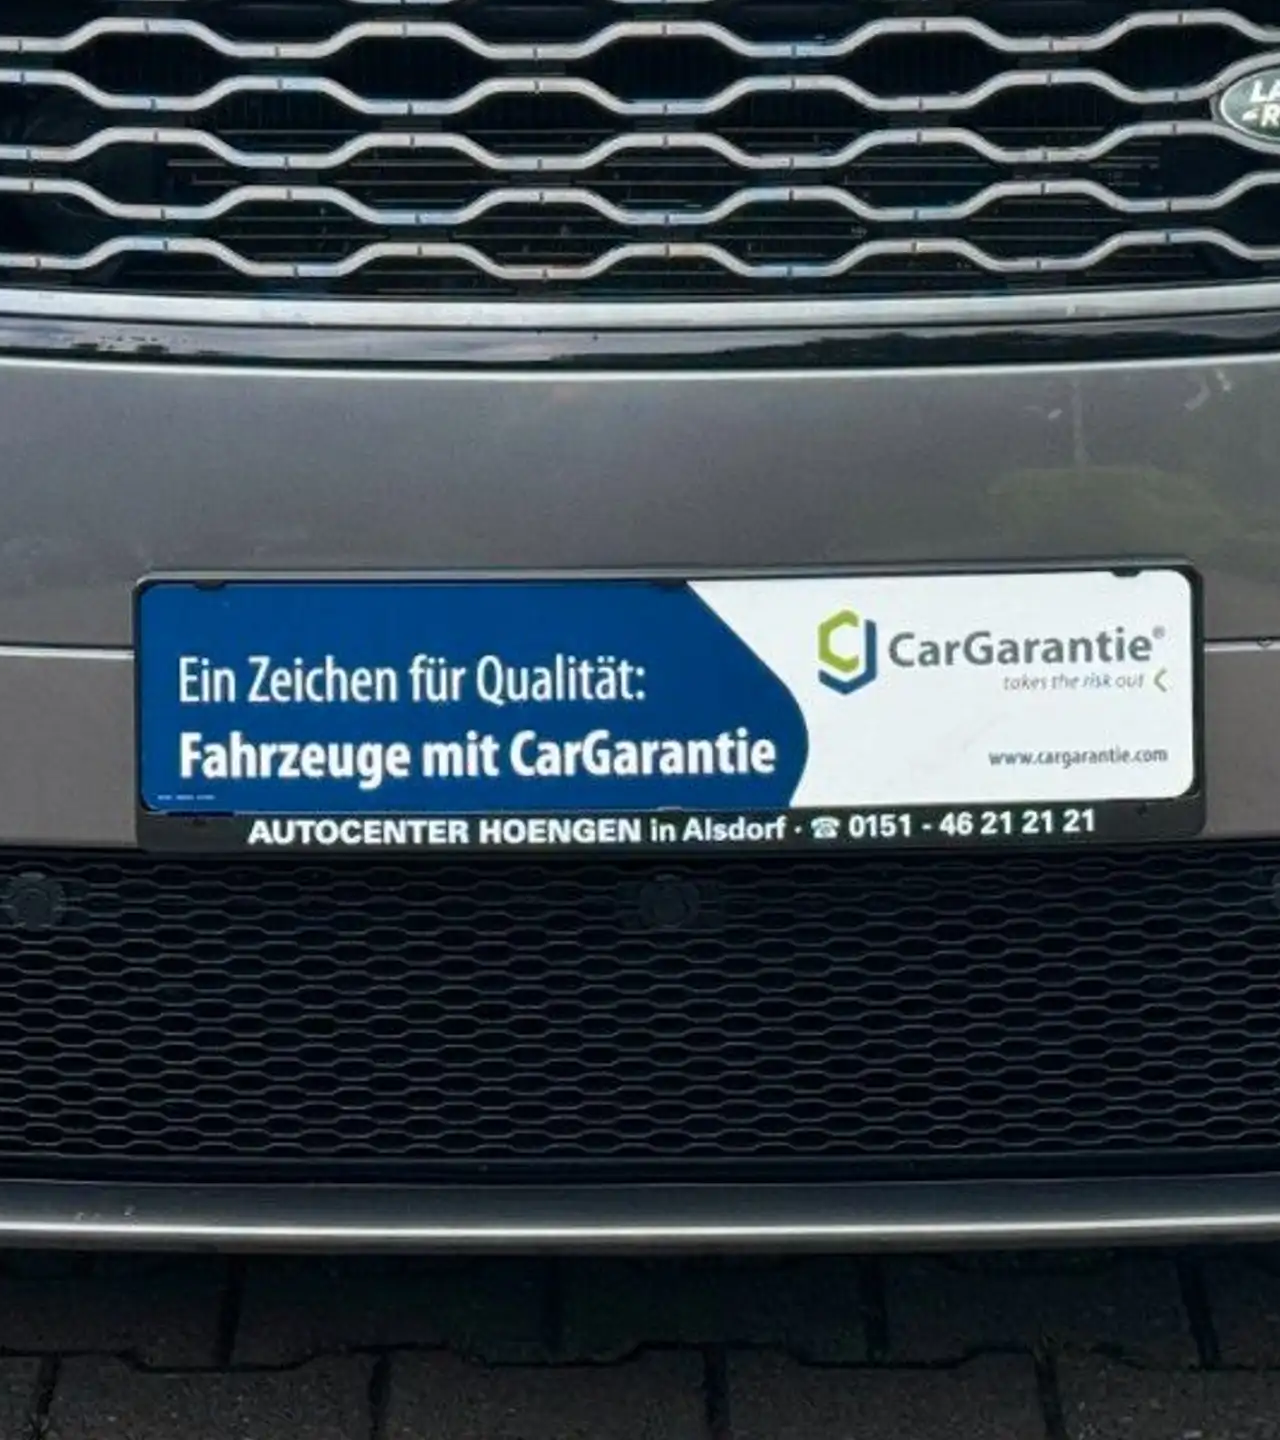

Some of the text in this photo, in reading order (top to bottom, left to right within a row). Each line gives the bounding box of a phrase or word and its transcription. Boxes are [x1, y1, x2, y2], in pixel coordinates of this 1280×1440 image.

[179, 653, 647, 707] Ein Zeichen für Qualität:
[1003, 671, 1145, 691] takes the risk out
[179, 726, 777, 791] Fahrzeuge mit CarGarantie
[988, 745, 1169, 769] www.cargarantie.com
[247, 818, 470, 846] AUTOCENTER
[479, 817, 642, 845] HOENGEN
[651, 817, 675, 843] in
[683, 816, 789, 842] Alsdorf
[848, 813, 912, 838] 0151
[939, 811, 974, 836] 46
[980, 810, 1013, 835] 21
[1022, 809, 1054, 834] 21
[1062, 808, 1096, 833] 21
